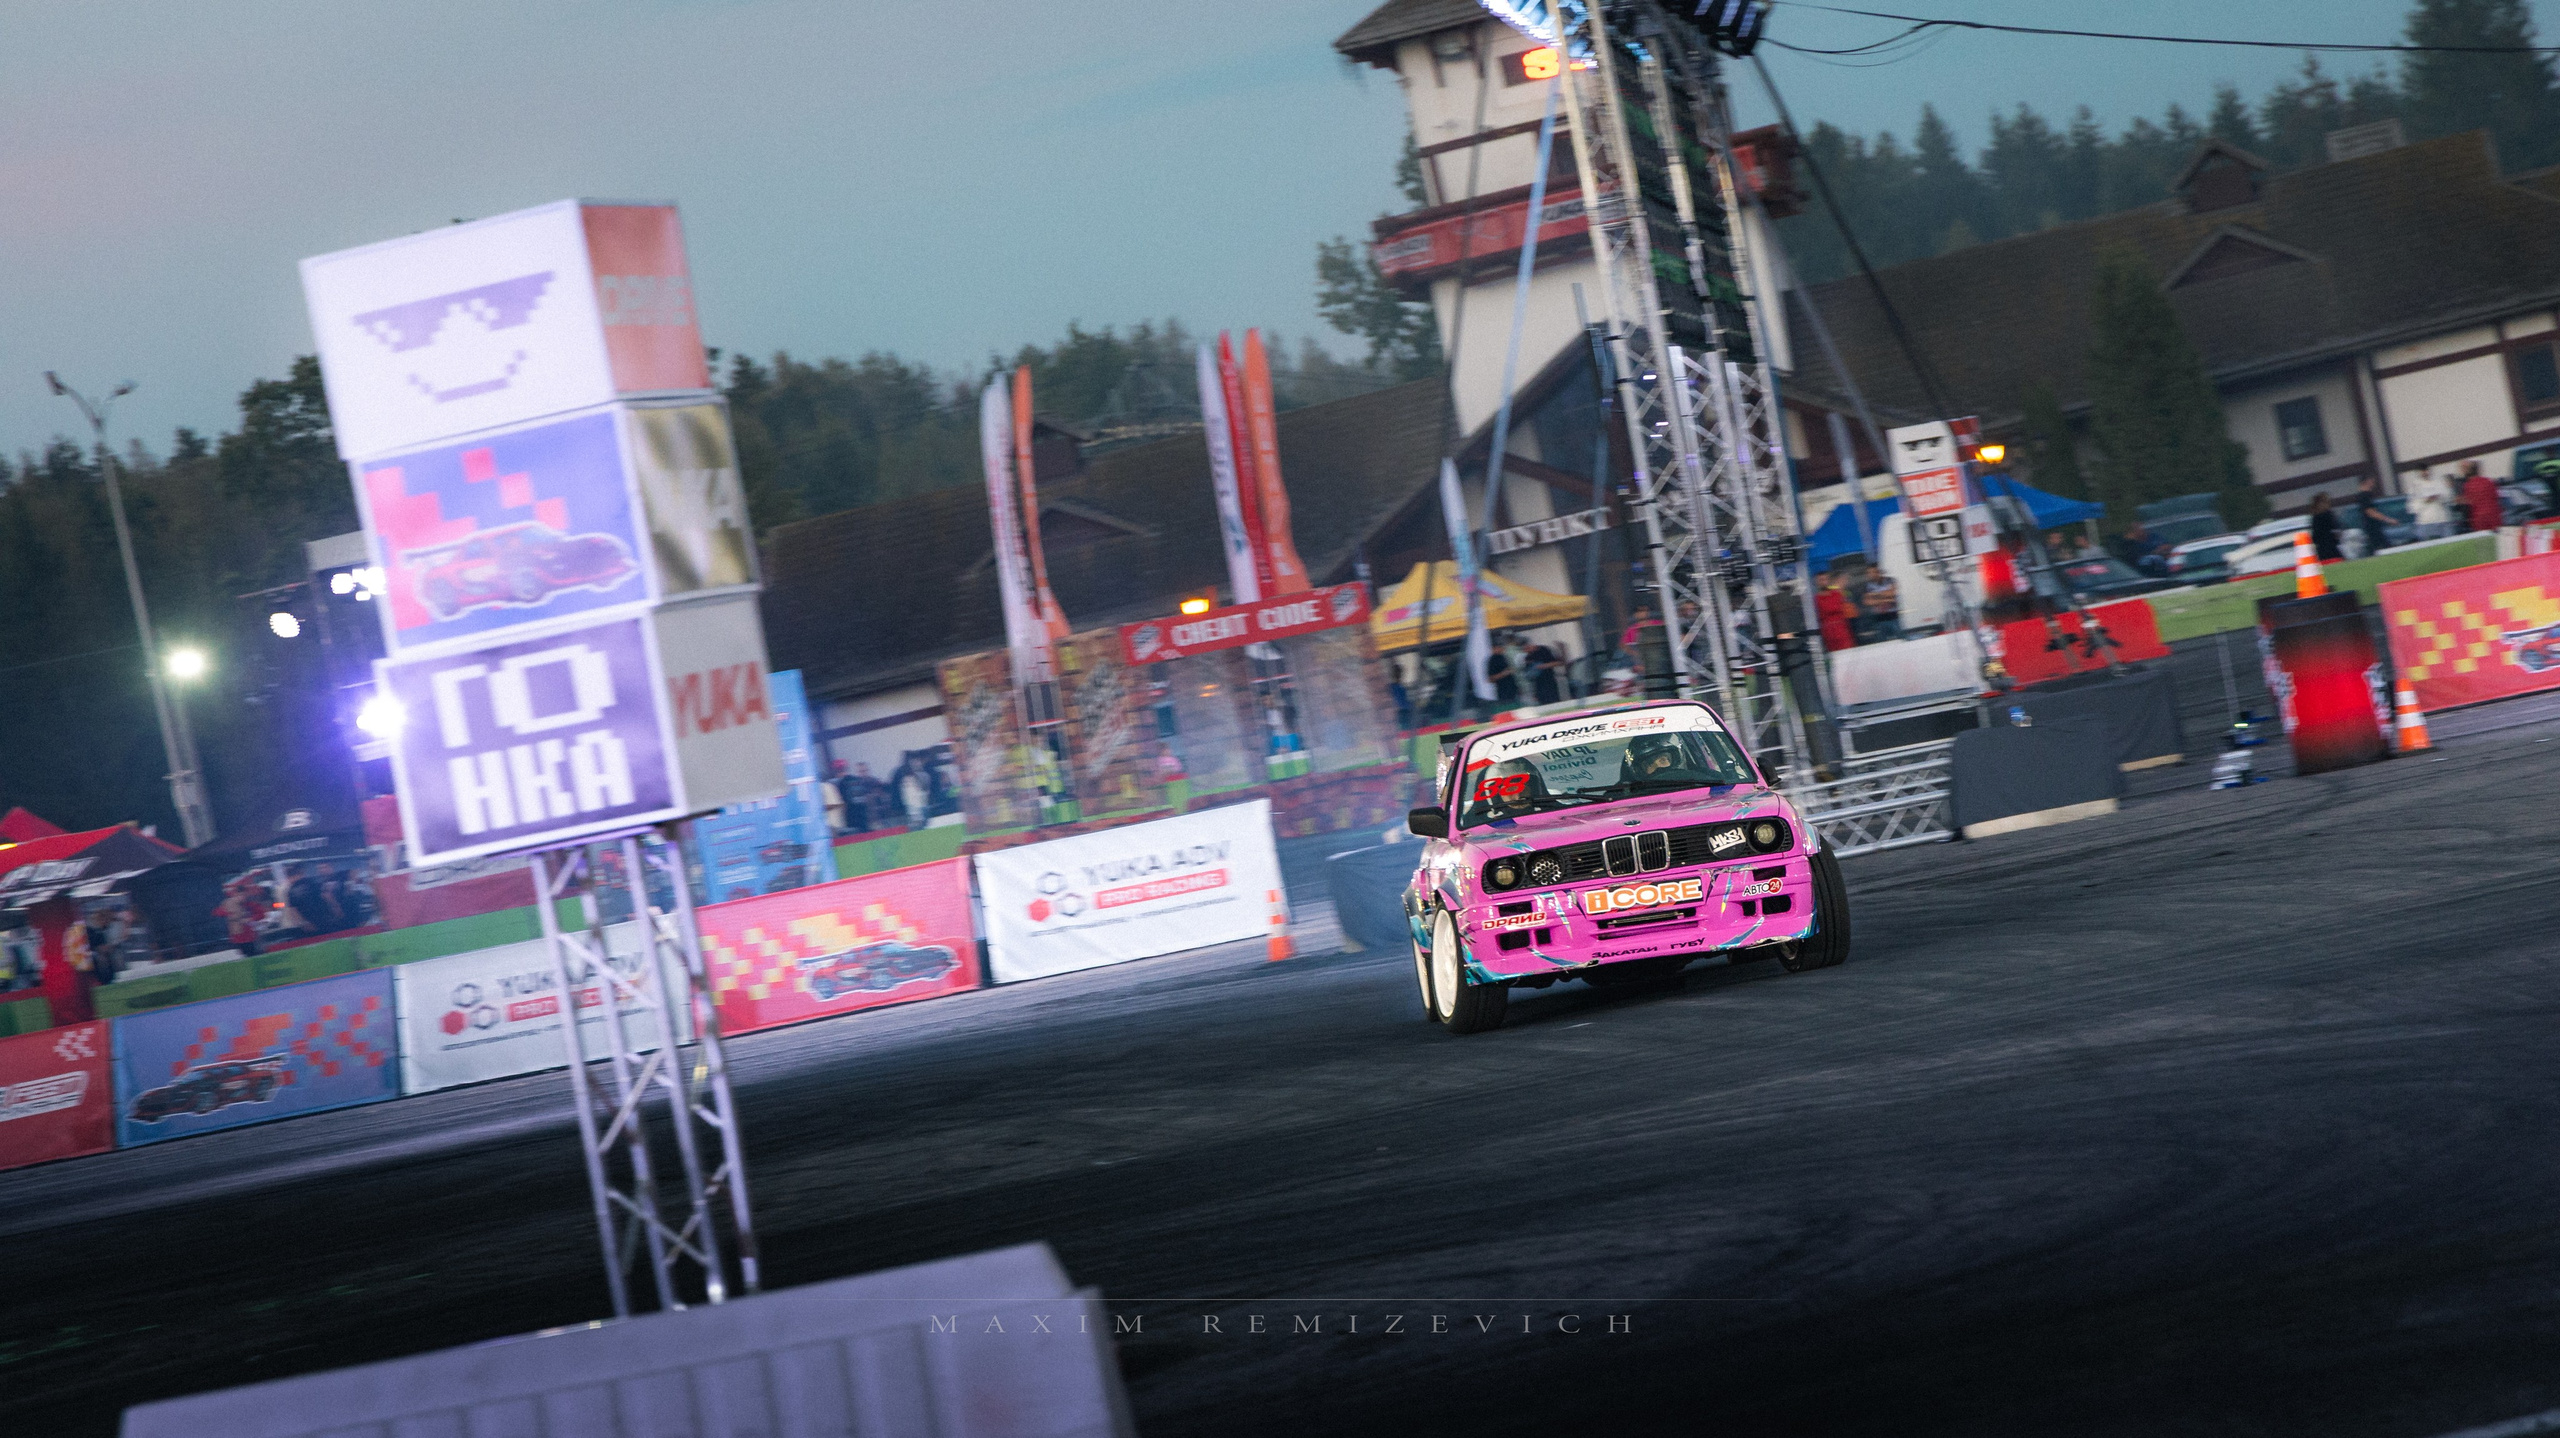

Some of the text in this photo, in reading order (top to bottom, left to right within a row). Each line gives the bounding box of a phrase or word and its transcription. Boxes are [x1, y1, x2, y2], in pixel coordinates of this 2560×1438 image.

[431, 643, 618, 749] ГО
[667, 660, 769, 739] YUKA
[1502, 734, 1547, 751] YUKA
[1551, 723, 1609, 740] DRIVE
[447, 729, 637, 836] НКА
[1473, 773, 1530, 802] 88
[1080, 853, 1164, 886] YUKA
